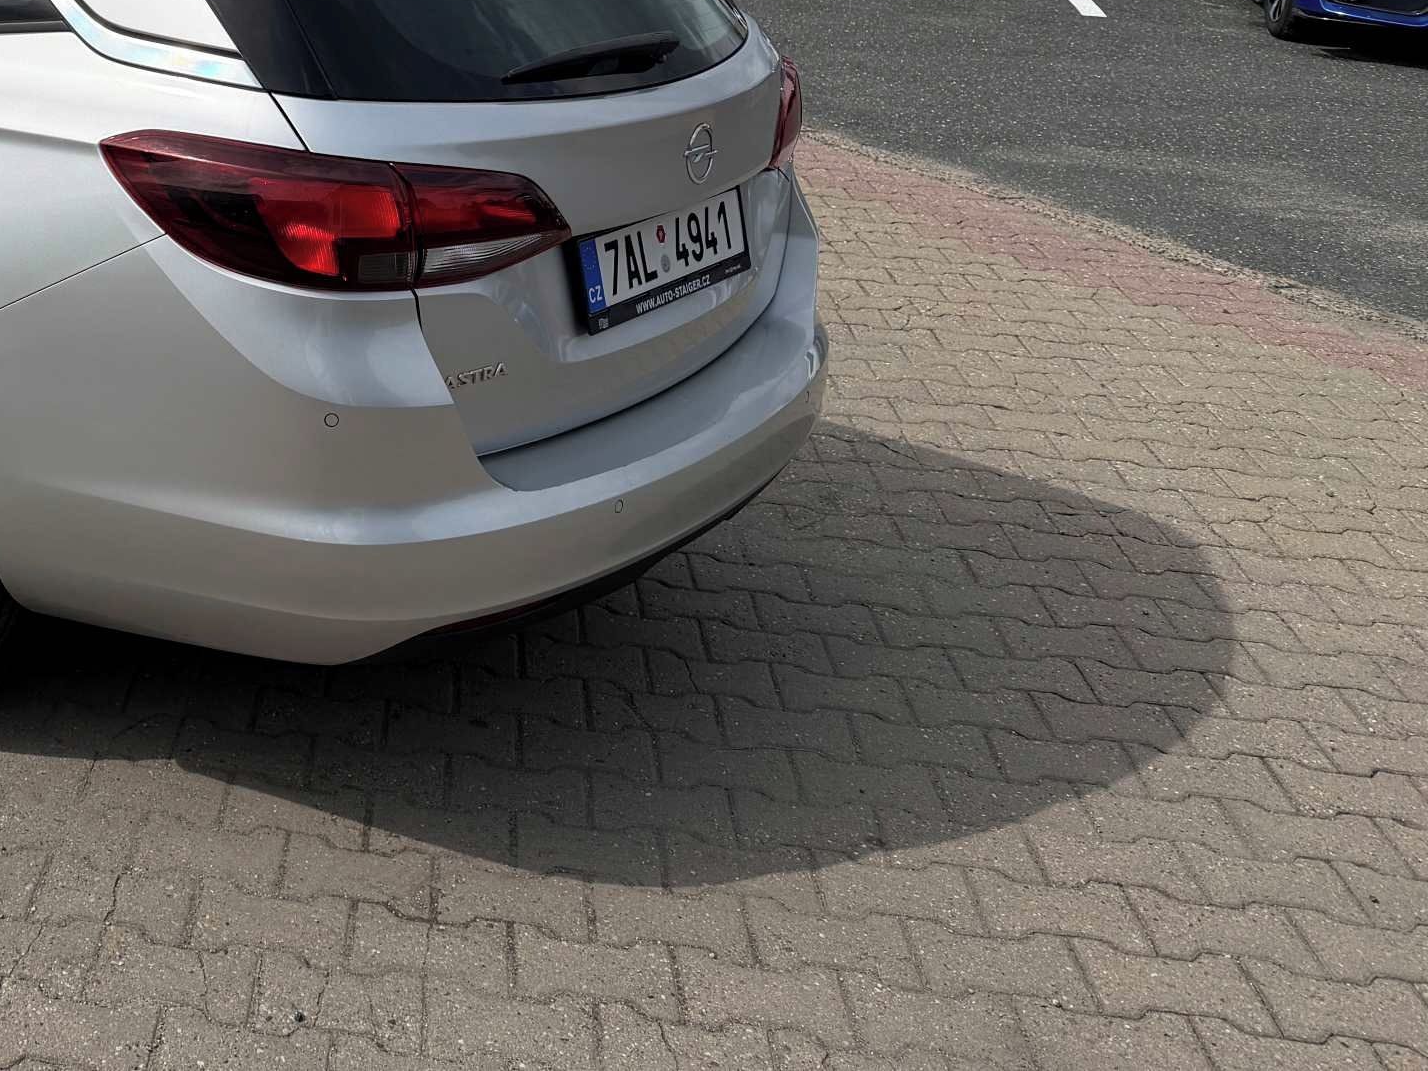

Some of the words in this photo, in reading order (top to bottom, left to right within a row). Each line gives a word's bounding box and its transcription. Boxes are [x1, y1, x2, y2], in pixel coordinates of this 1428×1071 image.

[604, 230, 658, 296] 7AL
[675, 201, 732, 267] 4941
[588, 285, 603, 304] CZ
[635, 274, 711, 314] WWW.AUTO-STAIGER.CZ
[445, 362, 509, 389] ASTRA
